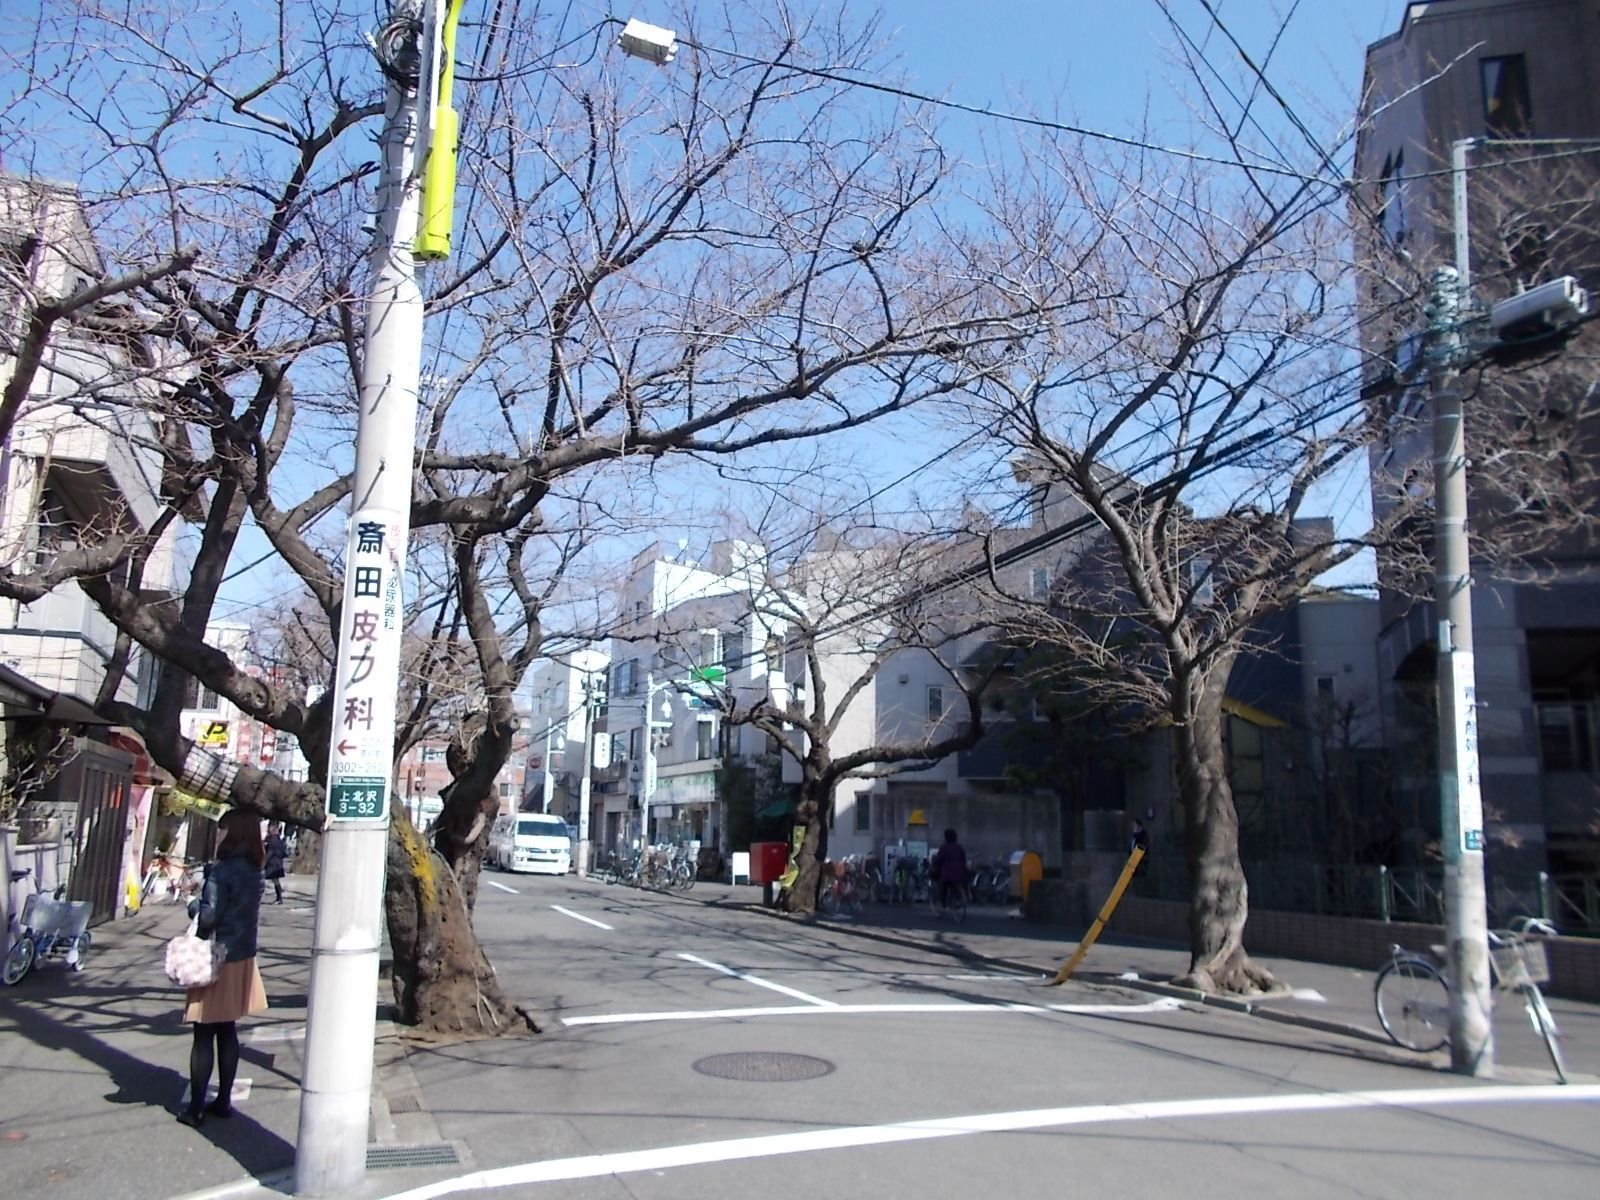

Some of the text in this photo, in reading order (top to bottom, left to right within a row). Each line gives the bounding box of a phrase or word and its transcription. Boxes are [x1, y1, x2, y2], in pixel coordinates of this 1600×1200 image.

[339, 790, 378, 802] 上北沢
[339, 802, 376, 814] 3-32
